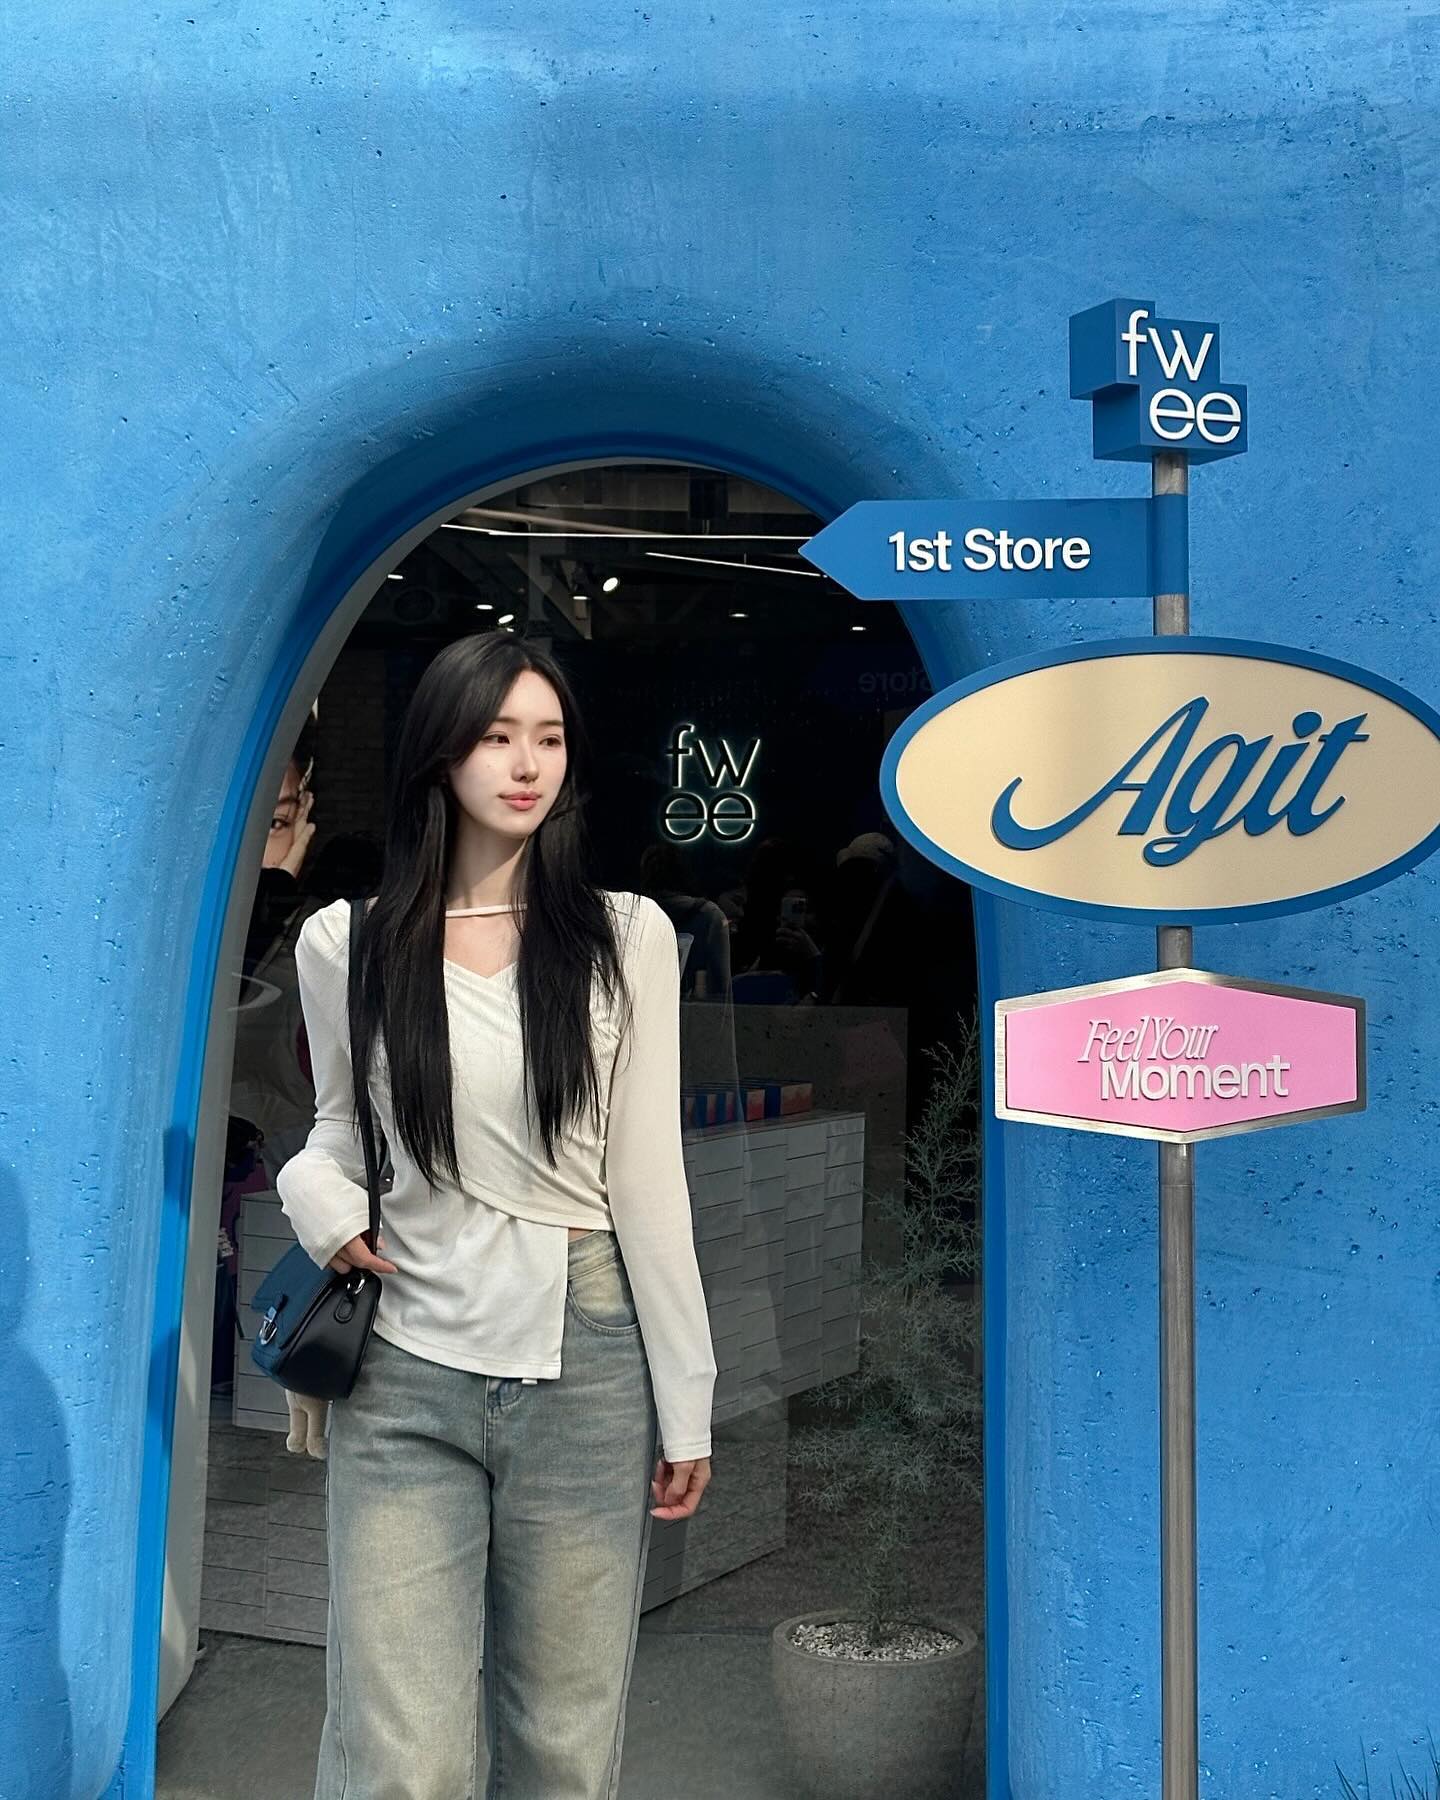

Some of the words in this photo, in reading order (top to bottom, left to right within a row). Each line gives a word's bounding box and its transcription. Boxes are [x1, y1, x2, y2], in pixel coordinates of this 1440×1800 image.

[1122, 309, 1214, 382] fw
[1148, 387, 1241, 444] ee
[888, 531, 952, 572] 1st
[963, 527, 1092, 571] Store
[667, 722, 761, 789] fw
[991, 695, 1369, 867] Agit
[662, 790, 756, 843] ee
[1077, 1015, 1150, 1063] Feel
[1100, 1054, 1291, 1100] Moment
